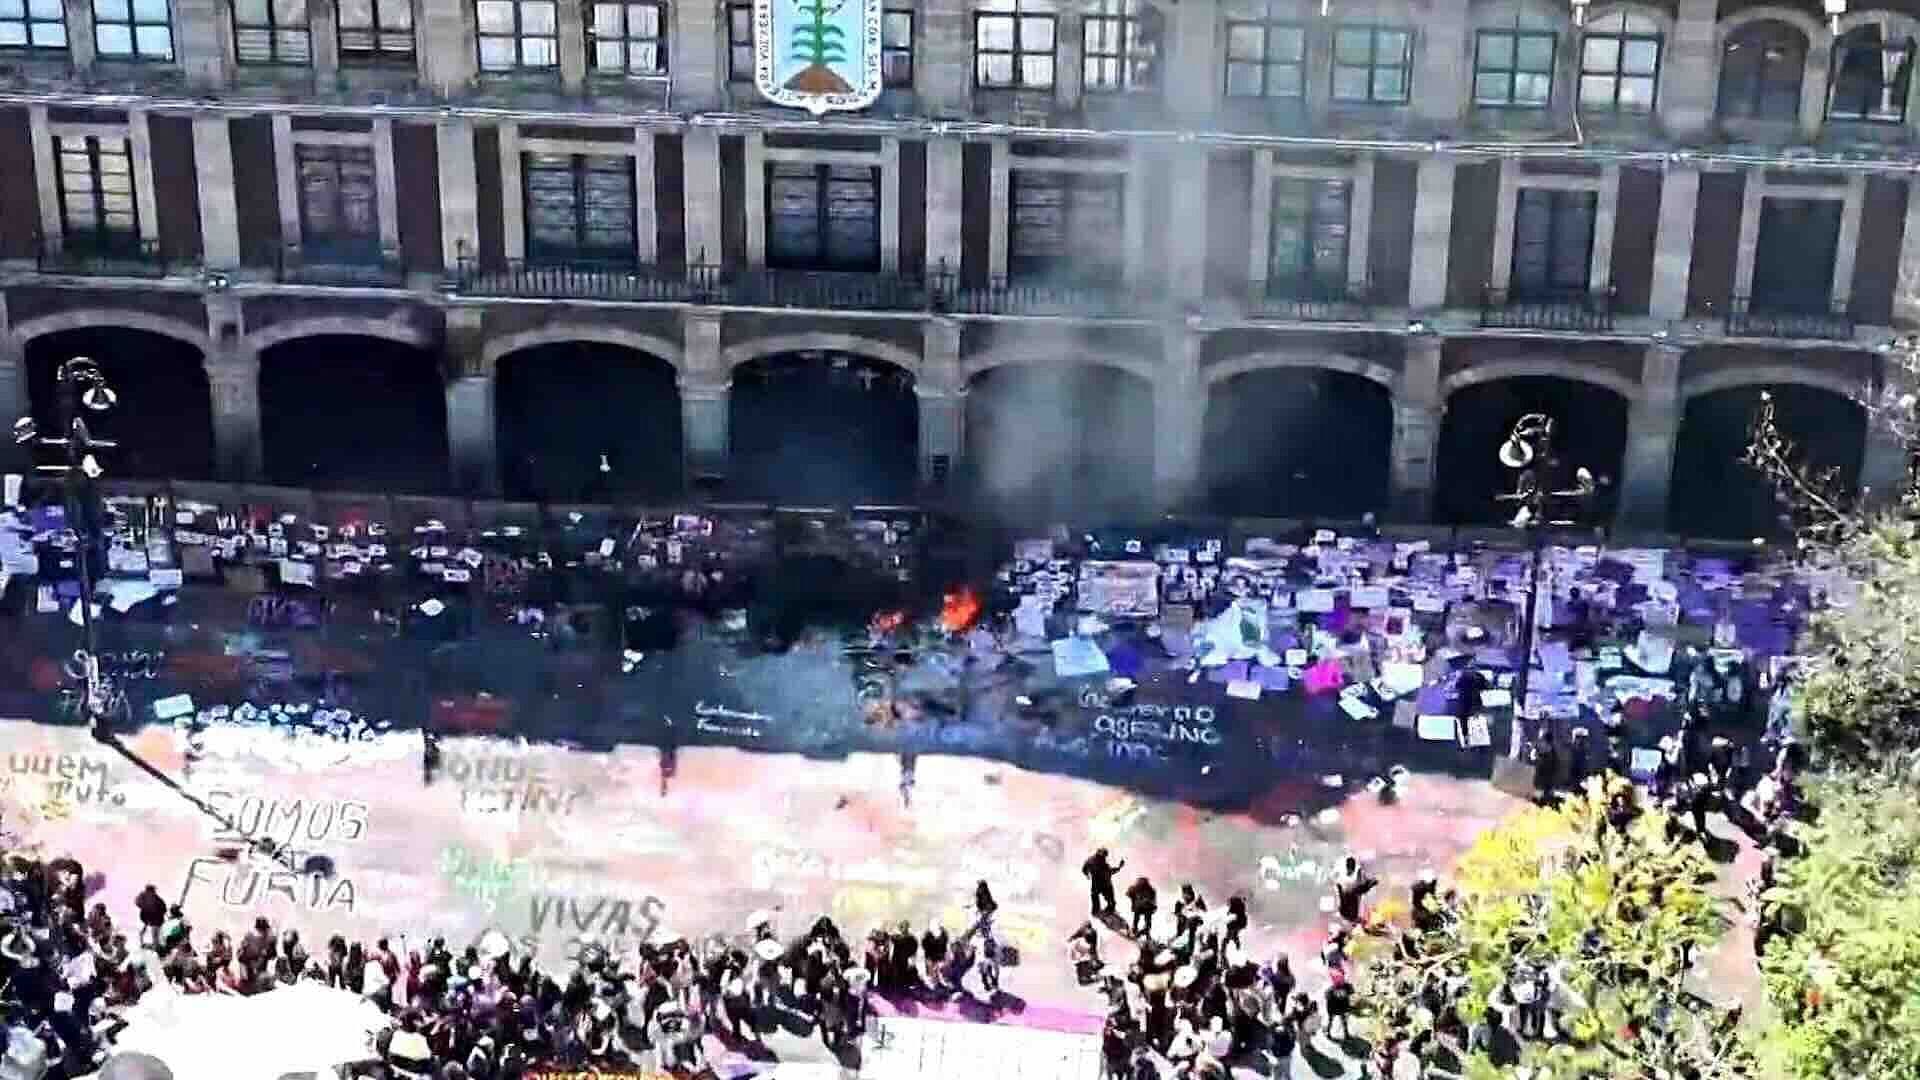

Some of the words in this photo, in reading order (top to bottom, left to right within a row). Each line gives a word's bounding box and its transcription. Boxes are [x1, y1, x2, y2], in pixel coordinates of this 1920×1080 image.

[208, 790, 367, 843] SOMOS
[179, 857, 355, 912] FURIA
[531, 896, 666, 941] VIVAS
